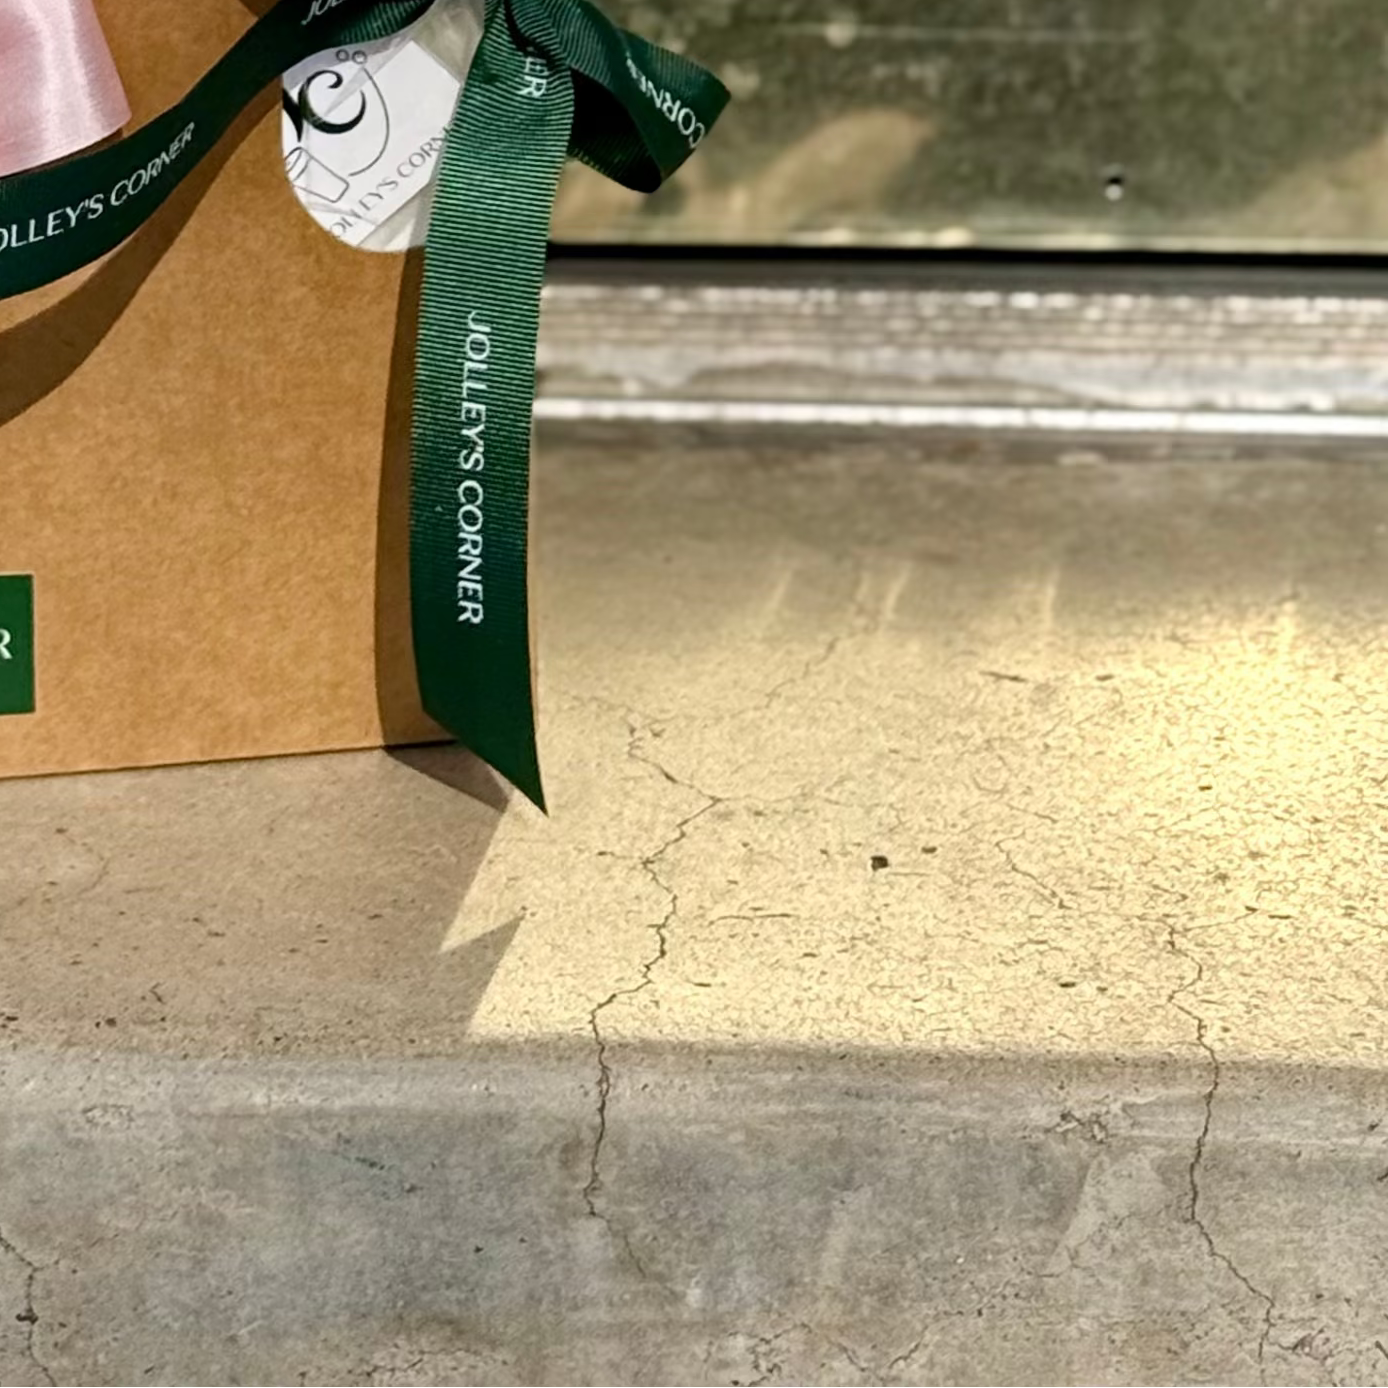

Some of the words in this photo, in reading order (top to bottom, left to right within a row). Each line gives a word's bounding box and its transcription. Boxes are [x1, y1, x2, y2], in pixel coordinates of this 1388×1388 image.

[111, 122, 195, 206] CORNER
[330, 177, 399, 239] OLLEY'S
[396, 120, 454, 178] CORN
[460, 311, 491, 471] JOLLEY'S
[456, 480, 484, 624] CORNER
